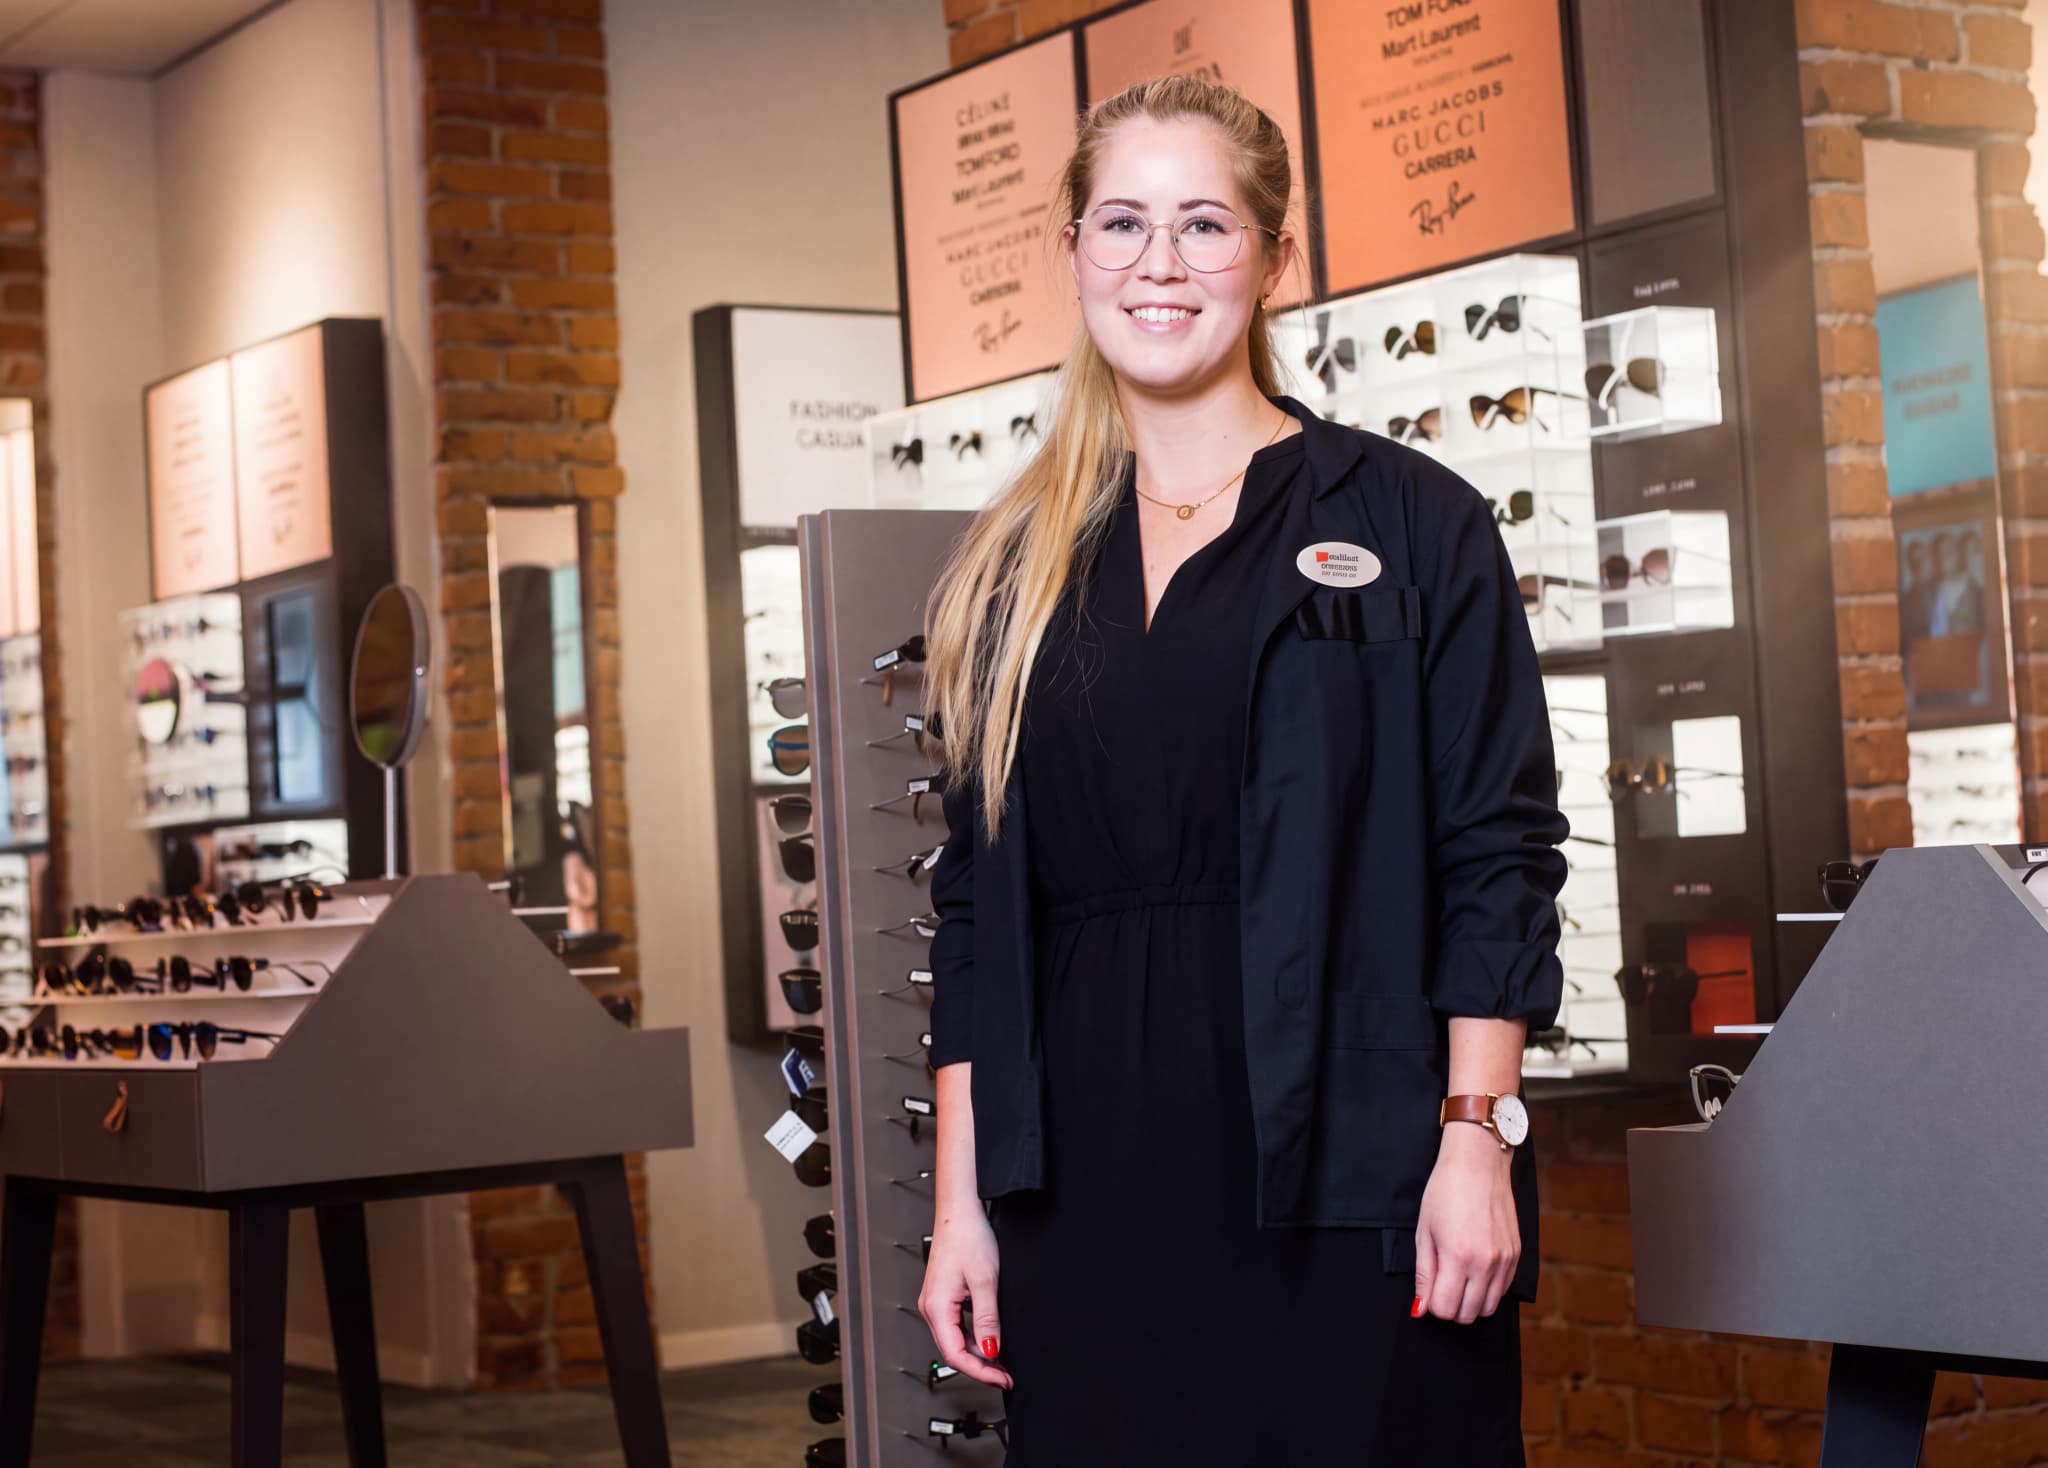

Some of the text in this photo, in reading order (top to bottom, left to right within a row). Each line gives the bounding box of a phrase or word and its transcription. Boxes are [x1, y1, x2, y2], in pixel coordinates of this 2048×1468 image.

[1381, 36, 1417, 59] Mart
[1420, 13, 1480, 48] Laurent
[1386, 2, 1422, 29] TOM
[1372, 105, 1421, 131] MARC
[1428, 79, 1504, 116] JACOBS
[1392, 110, 1486, 157] GUCCI
[1404, 146, 1477, 179] CARRERA
[1408, 180, 1476, 235] Ray-Ban
